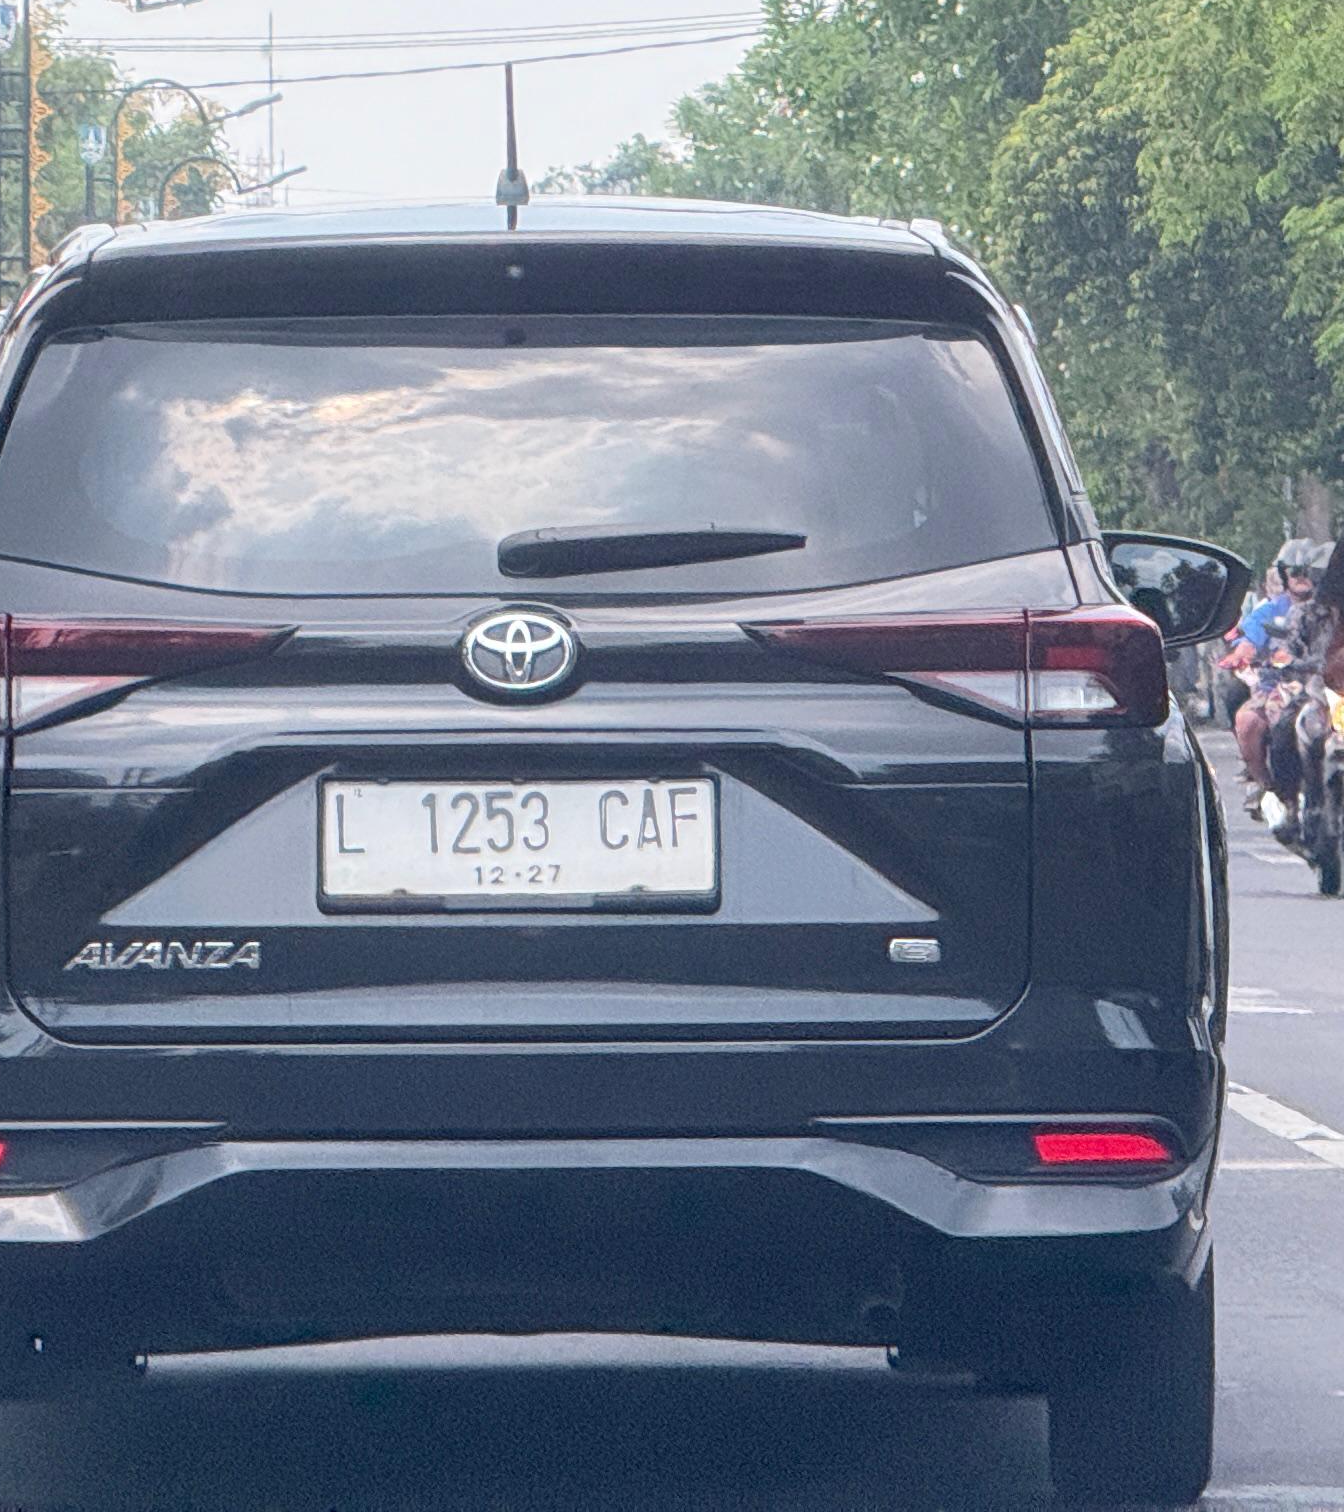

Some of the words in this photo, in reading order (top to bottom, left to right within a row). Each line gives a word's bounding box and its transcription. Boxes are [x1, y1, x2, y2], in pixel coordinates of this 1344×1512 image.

[336, 793, 365, 855] L
[422, 790, 550, 854] 1253
[599, 787, 698, 851] CAF
[63, 941, 261, 970] AVANZA
